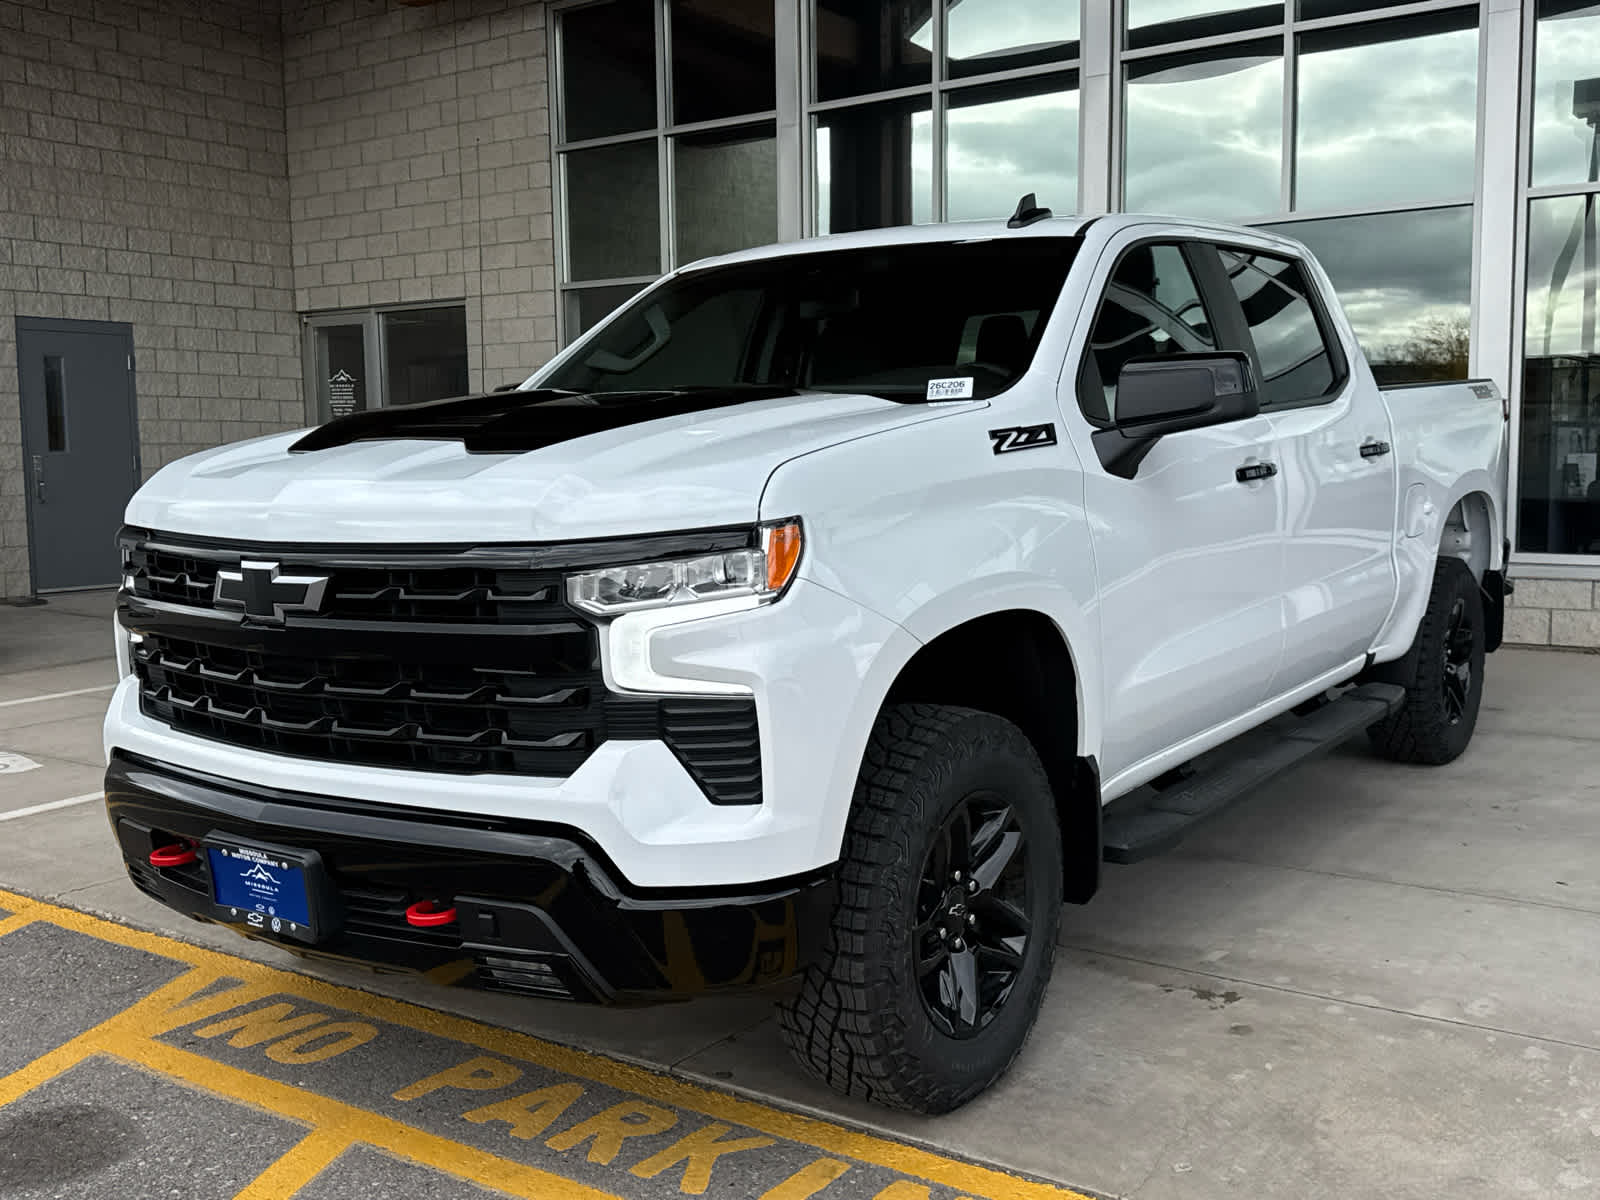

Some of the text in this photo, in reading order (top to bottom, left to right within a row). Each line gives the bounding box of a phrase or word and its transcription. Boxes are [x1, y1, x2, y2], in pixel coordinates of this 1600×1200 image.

[929, 380, 966, 390] 26C206
[193, 1002, 972, 1200] NO PARKI
